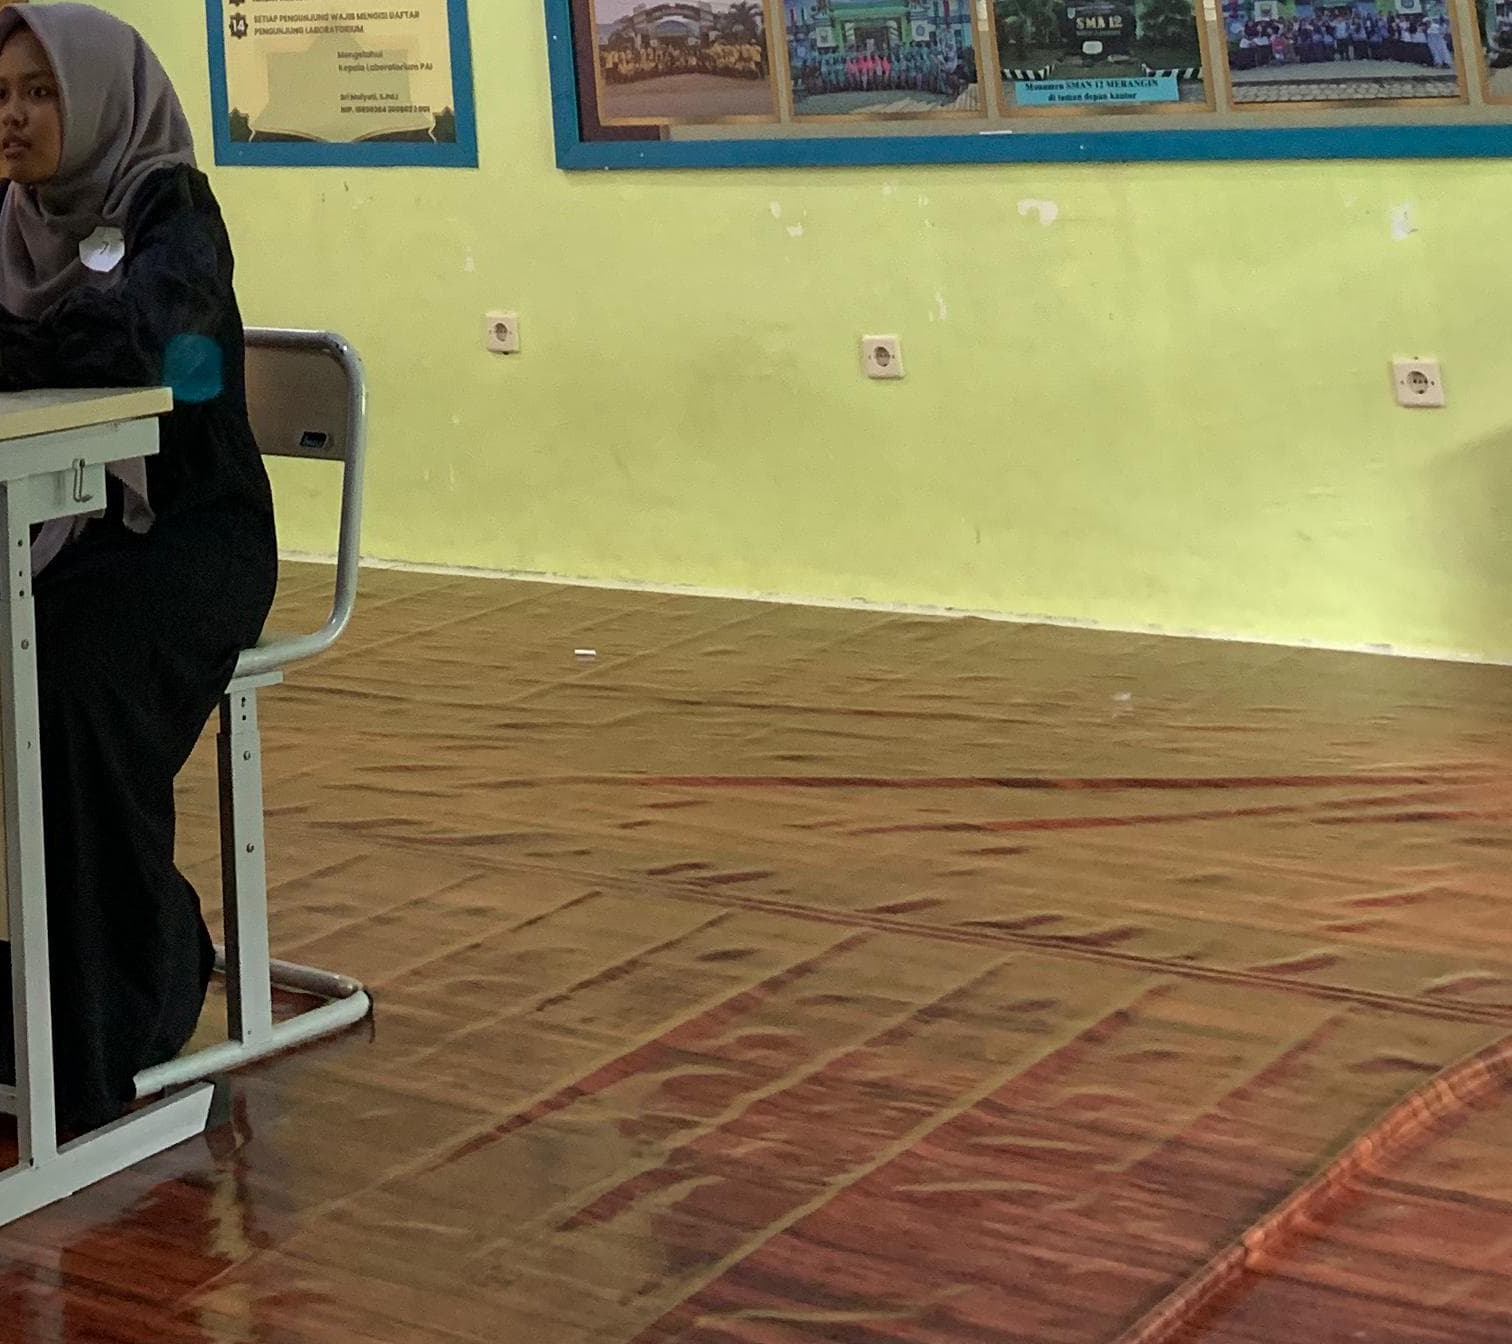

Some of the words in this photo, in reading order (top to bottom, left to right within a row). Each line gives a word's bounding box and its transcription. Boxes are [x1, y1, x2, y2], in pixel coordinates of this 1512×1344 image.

[1076, 17, 1106, 29] SMA
[1109, 16, 1123, 28] 12
[1105, 79, 1158, 89] MERANGIN
